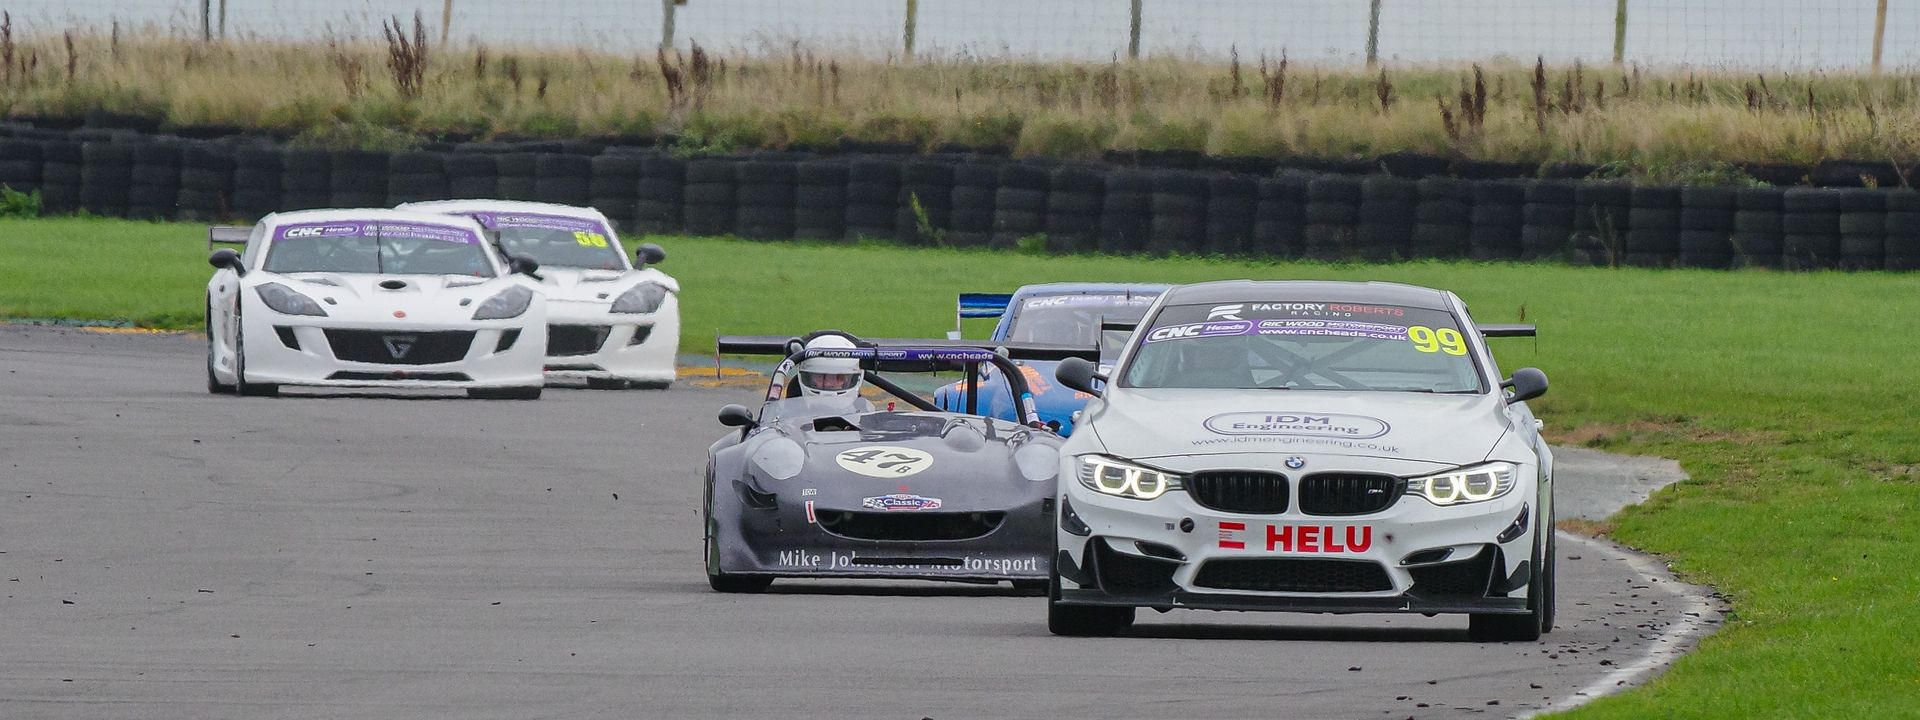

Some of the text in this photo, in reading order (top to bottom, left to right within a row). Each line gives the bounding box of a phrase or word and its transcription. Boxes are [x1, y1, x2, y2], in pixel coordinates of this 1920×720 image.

[287, 227, 323, 237] CNC
[1251, 303, 1405, 316] FACTORY ROBERTS
[1152, 325, 1204, 340] CNC
[1326, 322, 1405, 332] MOTORSPORT
[1258, 328, 1407, 341] www.cncheads.co.uk
[1408, 325, 1468, 356] 99
[1265, 415, 1330, 425] IDM
[1233, 423, 1360, 435] Engineering
[1191, 435, 1400, 453] www.idmengineering.co.uk
[841, 450, 923, 474] 47 B
[884, 498, 921, 506] Classic
[1266, 525, 1372, 553] HELU
[779, 549, 821, 567] Mike
